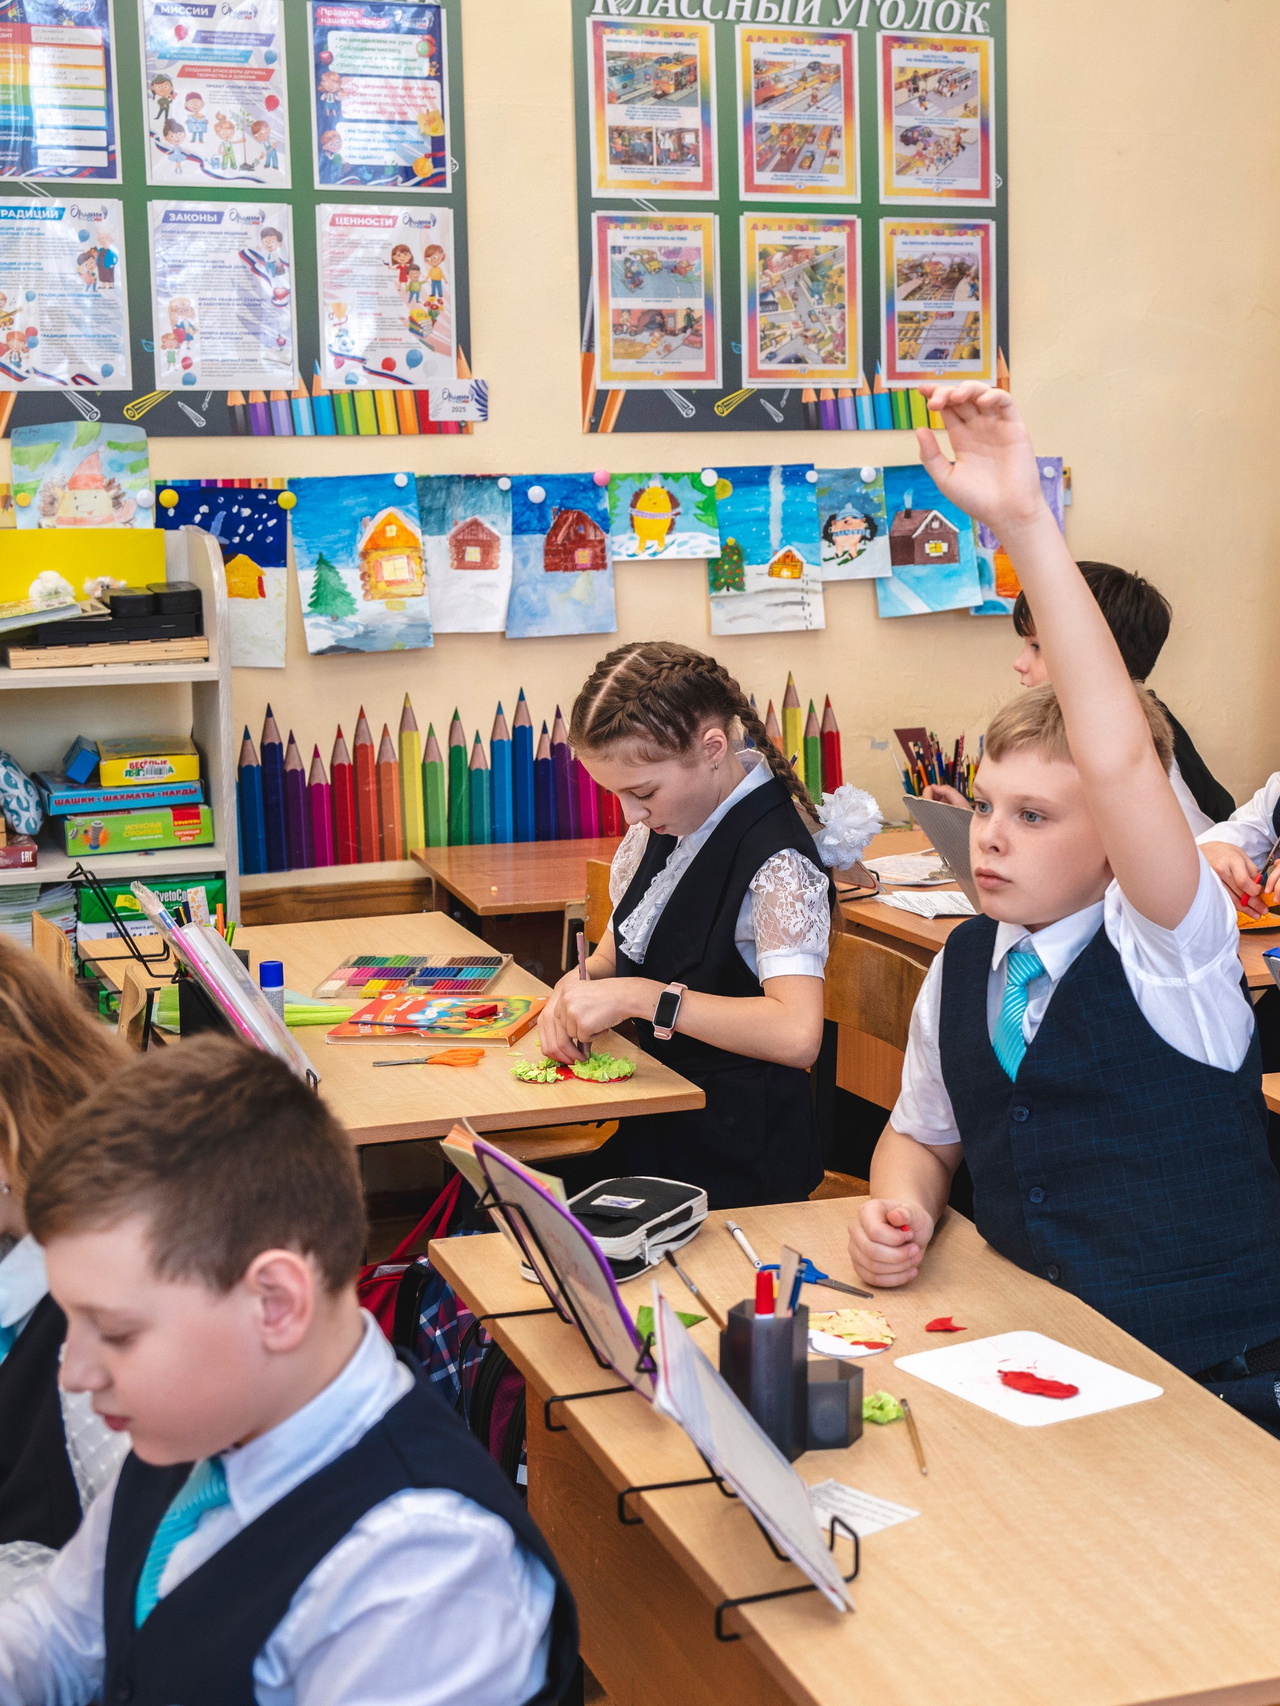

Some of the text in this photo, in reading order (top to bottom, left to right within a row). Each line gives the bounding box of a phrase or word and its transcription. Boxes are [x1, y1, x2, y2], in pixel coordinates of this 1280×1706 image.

[160, 4, 209, 16] МИССИИ
[320, 8, 359, 17] Правила
[832, 0, 991, 33] УГОЛОК
[320, 17, 386, 27] нашего класса
[0, 209, 59, 219] РАДИЦИИ
[169, 213, 218, 222] ЗАКОНЫ
[335, 216, 394, 226] ЦЕННОСТИ
[54, 788, 198, 806] ШАШКИ ШАХМАТЫ НАРДЫ
[125, 822, 162, 830] ИСКУСНЫЕ
[123, 829, 162, 838] СТРОИТЕЛИ
